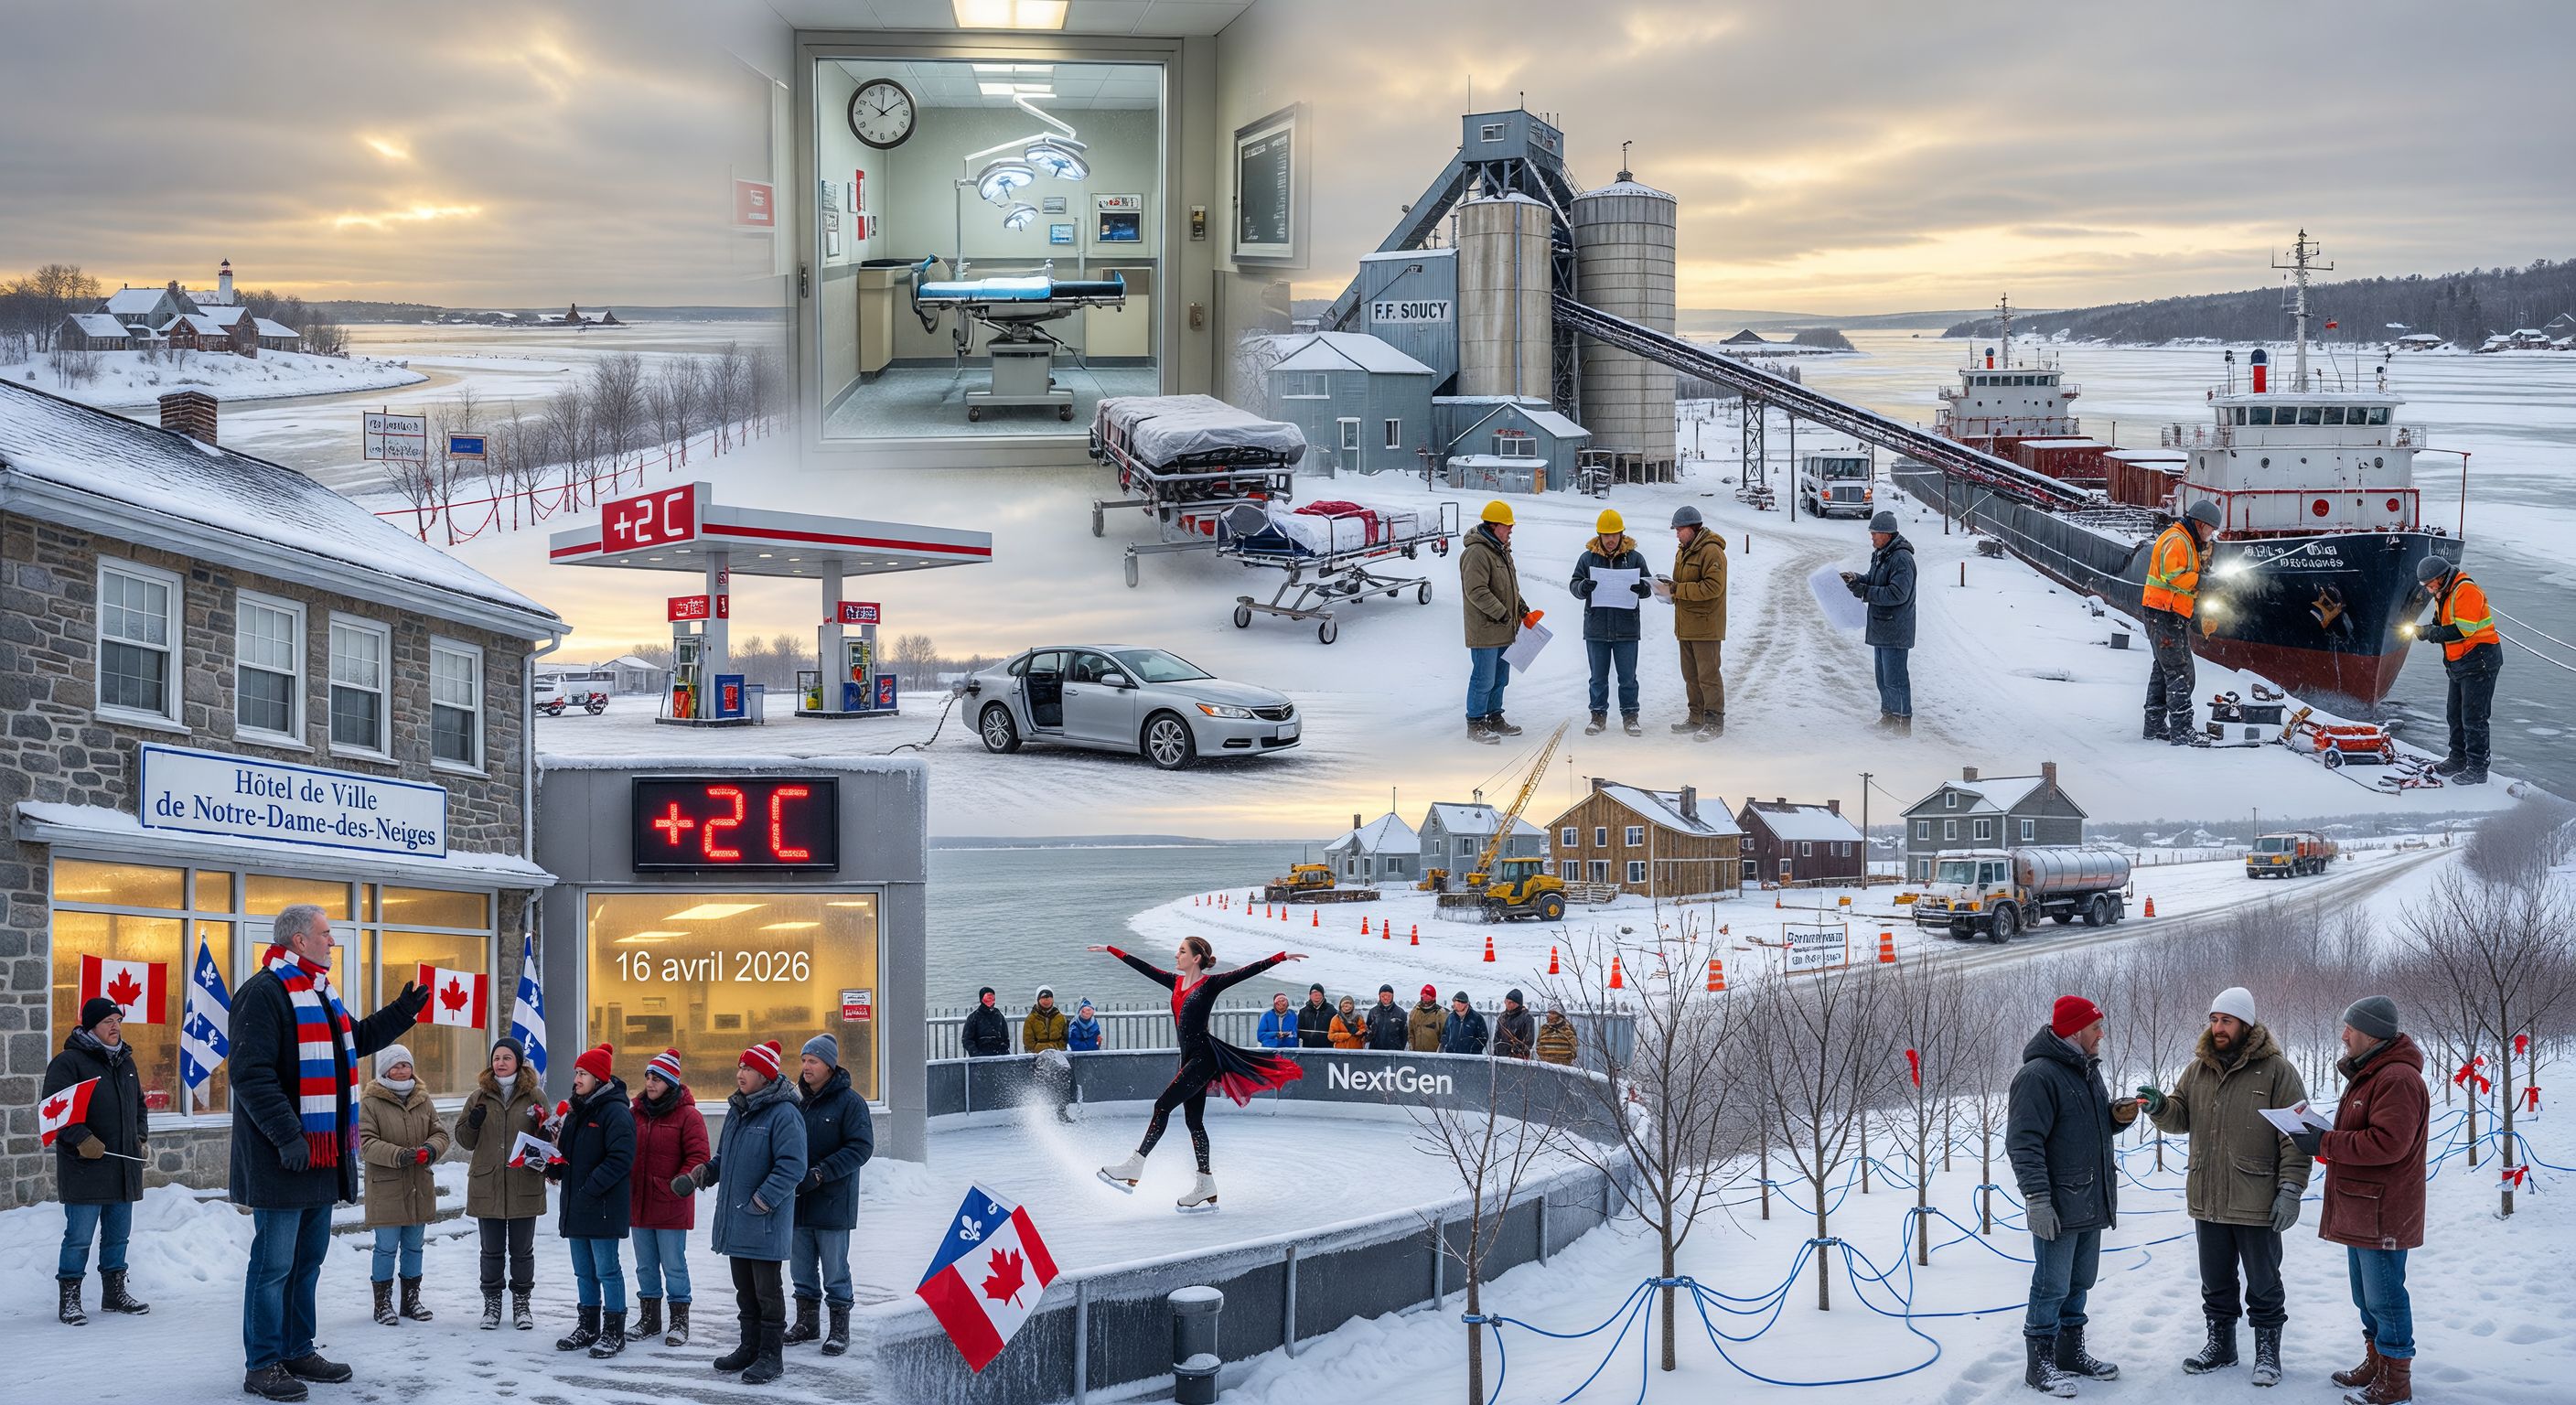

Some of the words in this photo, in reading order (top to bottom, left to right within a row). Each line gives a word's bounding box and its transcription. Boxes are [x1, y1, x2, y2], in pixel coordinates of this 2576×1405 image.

[1375, 304, 1396, 320] F.F.
[1401, 303, 1448, 319] SOUCY
[234, 768, 294, 800] Hôtel
[300, 778, 325, 803] de
[330, 782, 378, 810] Ville
[156, 790, 186, 818] de
[192, 794, 436, 851] Notre-Dame-des-Neiges
[616, 950, 650, 981] 16
[661, 950, 723, 982] avril
[735, 950, 810, 982] 2026
[1328, 1062, 1453, 1095] NextGen
